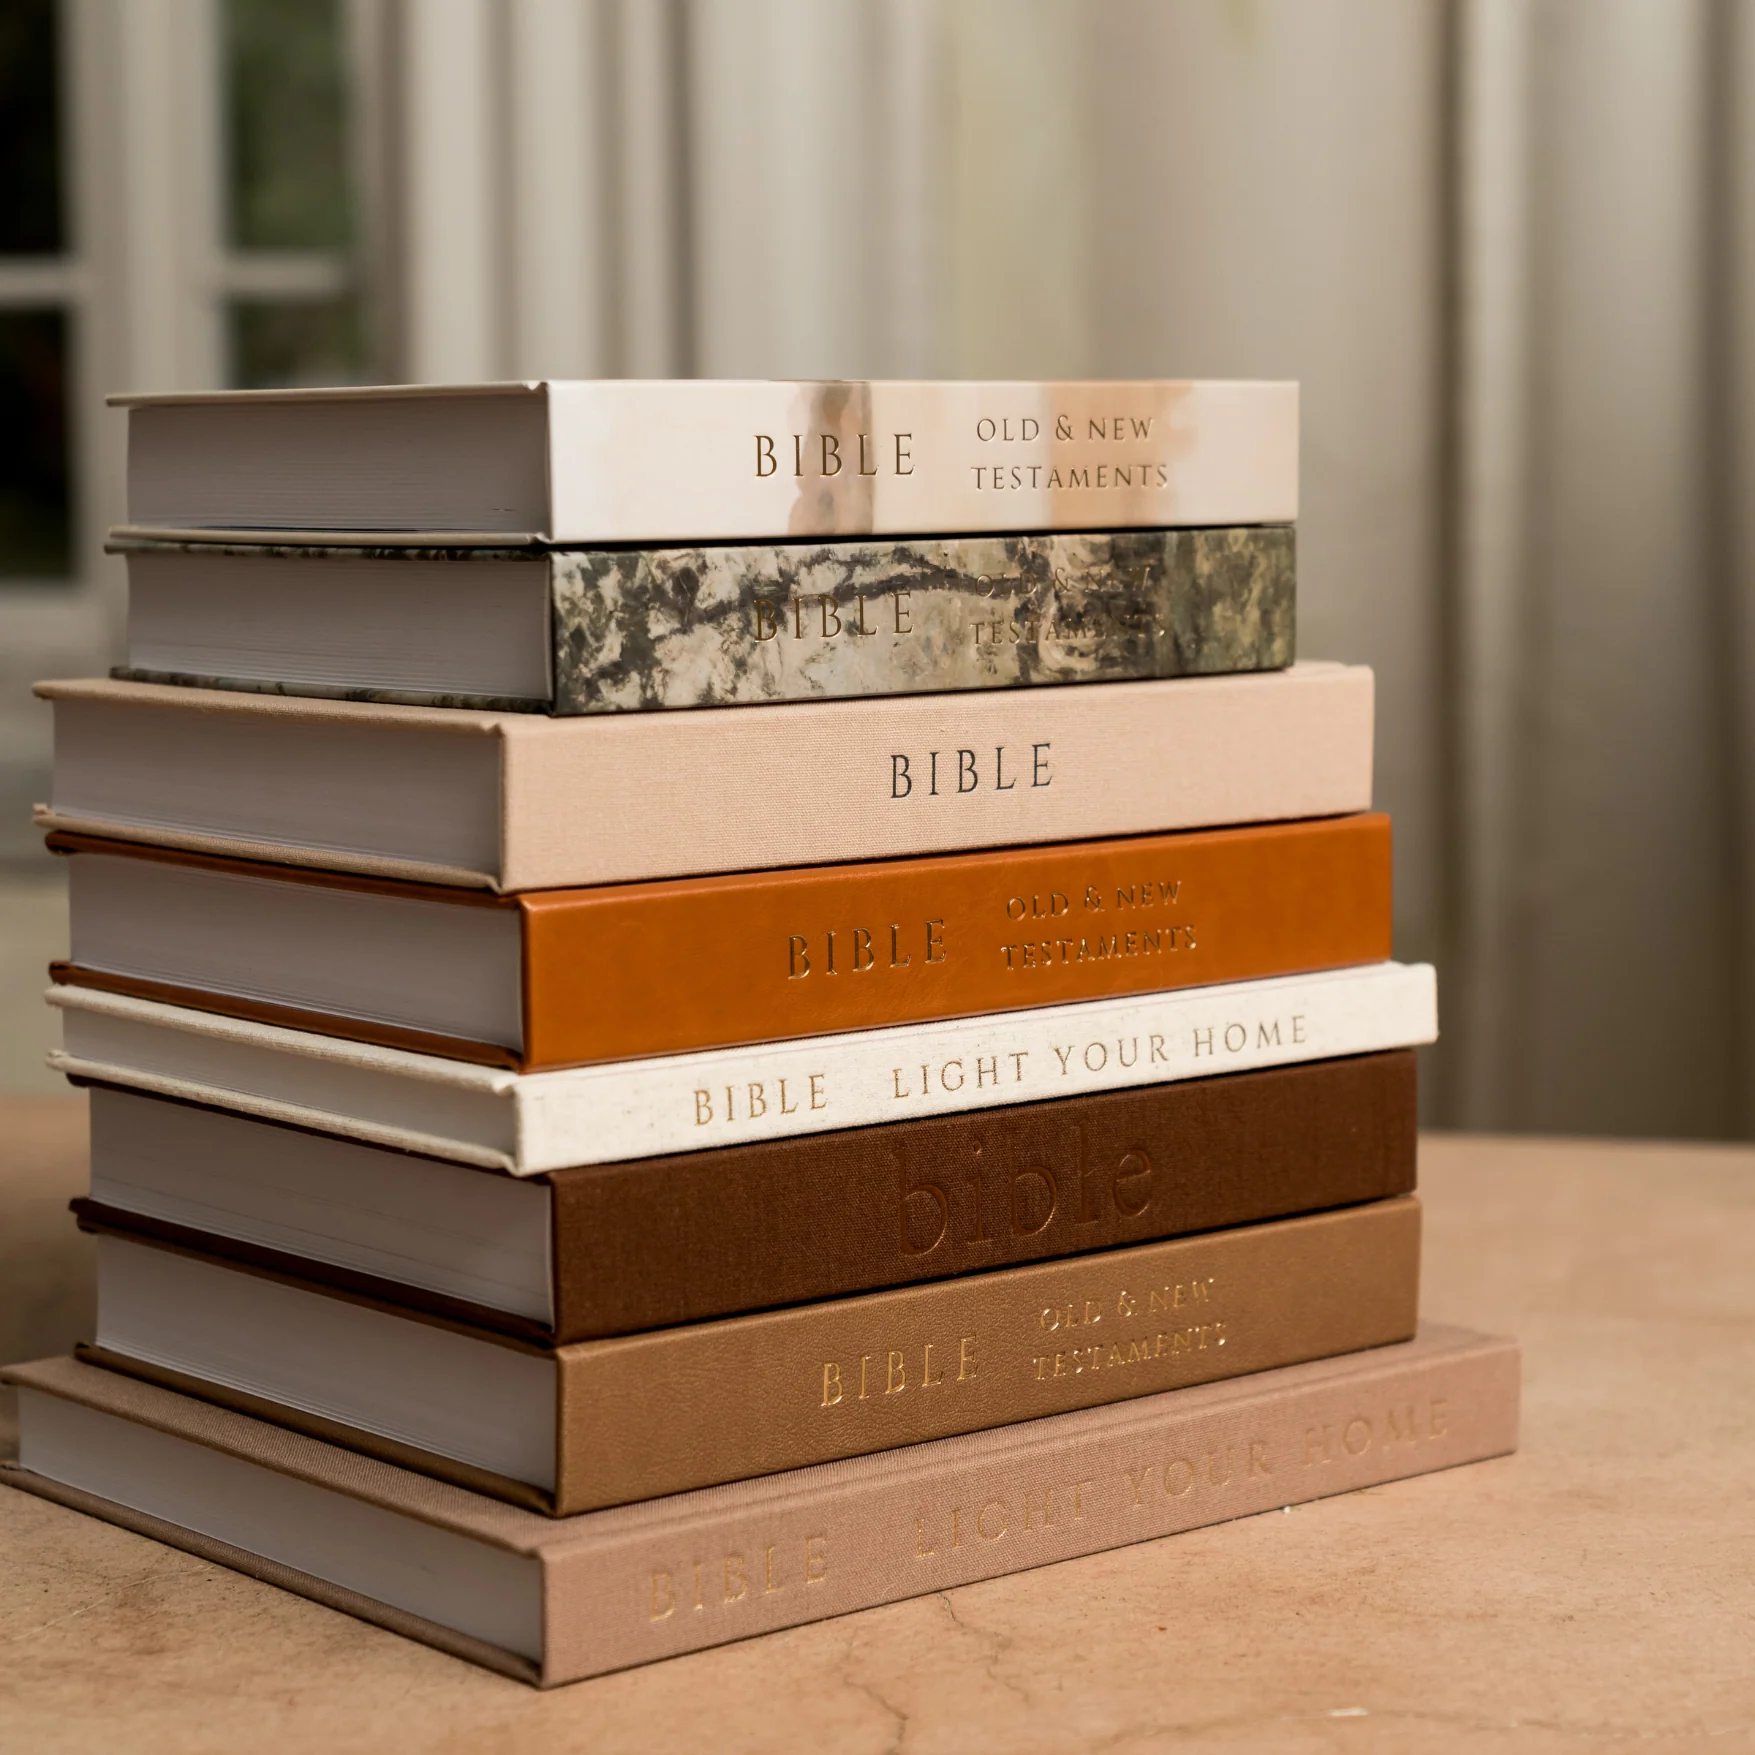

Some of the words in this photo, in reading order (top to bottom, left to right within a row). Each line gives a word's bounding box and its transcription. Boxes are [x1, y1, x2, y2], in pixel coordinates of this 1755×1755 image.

[754, 433, 916, 477] BIBLE
[976, 417, 1040, 442] OLD
[1055, 415, 1075, 442] &
[1087, 417, 1156, 441] NEW
[970, 464, 1169, 491] TESTAMENTS
[975, 572, 1038, 598] OLD
[1053, 568, 1073, 595] &
[753, 592, 915, 643] BIBLE
[890, 742, 1053, 799] BIBLE
[1006, 892, 1069, 922] OLD
[1084, 885, 1105, 913] &
[1115, 880, 1183, 911] NEW
[788, 919, 947, 981] BIBLE
[1000, 924, 1198, 971] TESTAMENTS
[693, 1073, 829, 1127] BIBLE
[893, 1051, 1030, 1099] LIGHT
[1052, 1034, 1171, 1077] YOUR
[1193, 1014, 1309, 1057] HOME
[892, 1117, 1151, 1255] bible
[1041, 1300, 1102, 1332] OLD
[1119, 1290, 1137, 1317] &
[1150, 1279, 1214, 1312] NEW
[820, 1334, 980, 1407] BIBLE
[1032, 1320, 1228, 1381] TESTAMENTS
[650, 1535, 828, 1622] BIBLE
[915, 1480, 1093, 1560] LIGHT
[1123, 1442, 1272, 1507] YOUR
